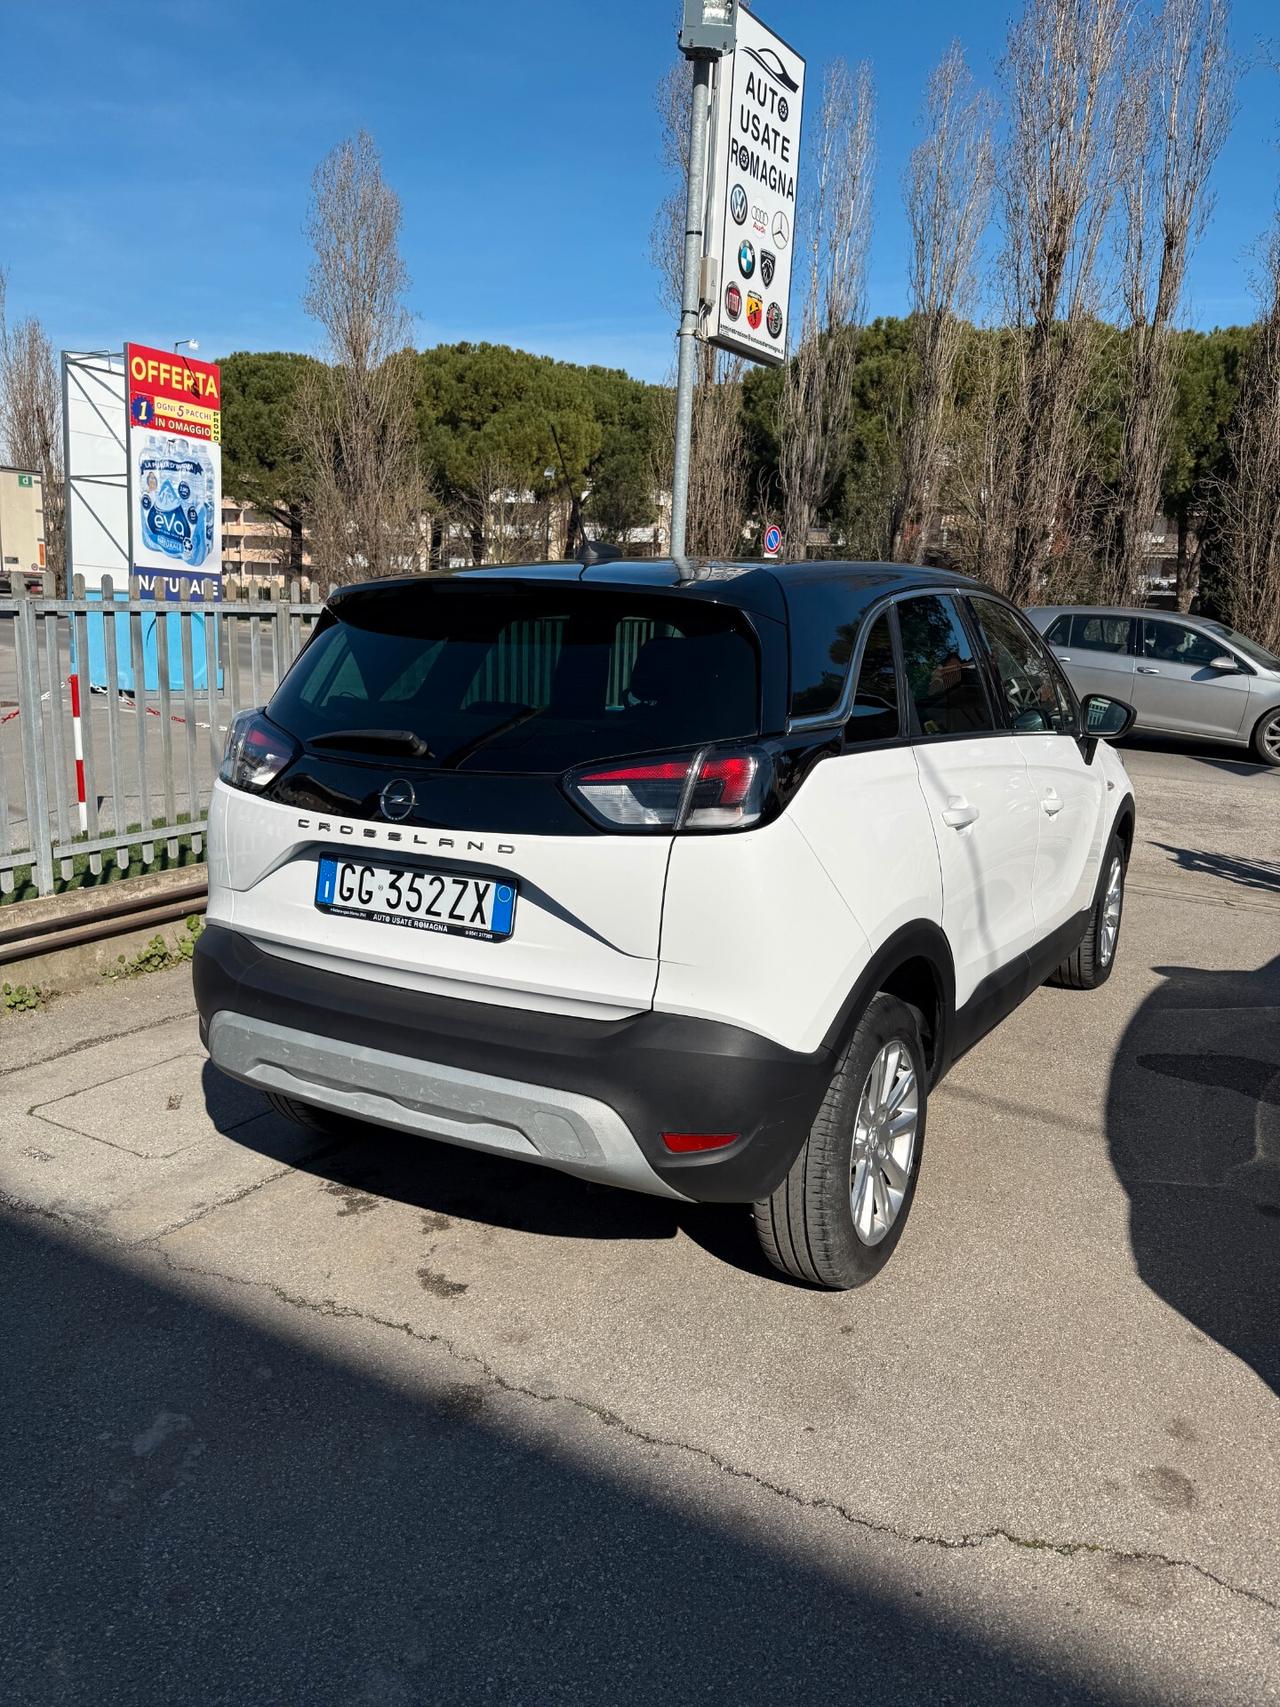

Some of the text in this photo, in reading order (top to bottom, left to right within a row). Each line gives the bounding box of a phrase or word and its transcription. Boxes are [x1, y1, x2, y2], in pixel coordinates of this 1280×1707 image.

[745, 71, 789, 122] AUTO
[740, 104, 791, 163] USATE
[730, 137, 795, 202] ROMAGNA
[131, 356, 218, 399] OFFERTA
[138, 401, 147, 421] 1
[155, 417, 211, 436] IN OMAGGIO
[156, 402, 212, 420] OGNI 5 PACCHI
[297, 818, 516, 855] CROSSLAND
[338, 863, 376, 905] GG
[385, 869, 491, 926] 352ZX
[372, 913, 448, 933] AUTO USATE ROMAGNA
